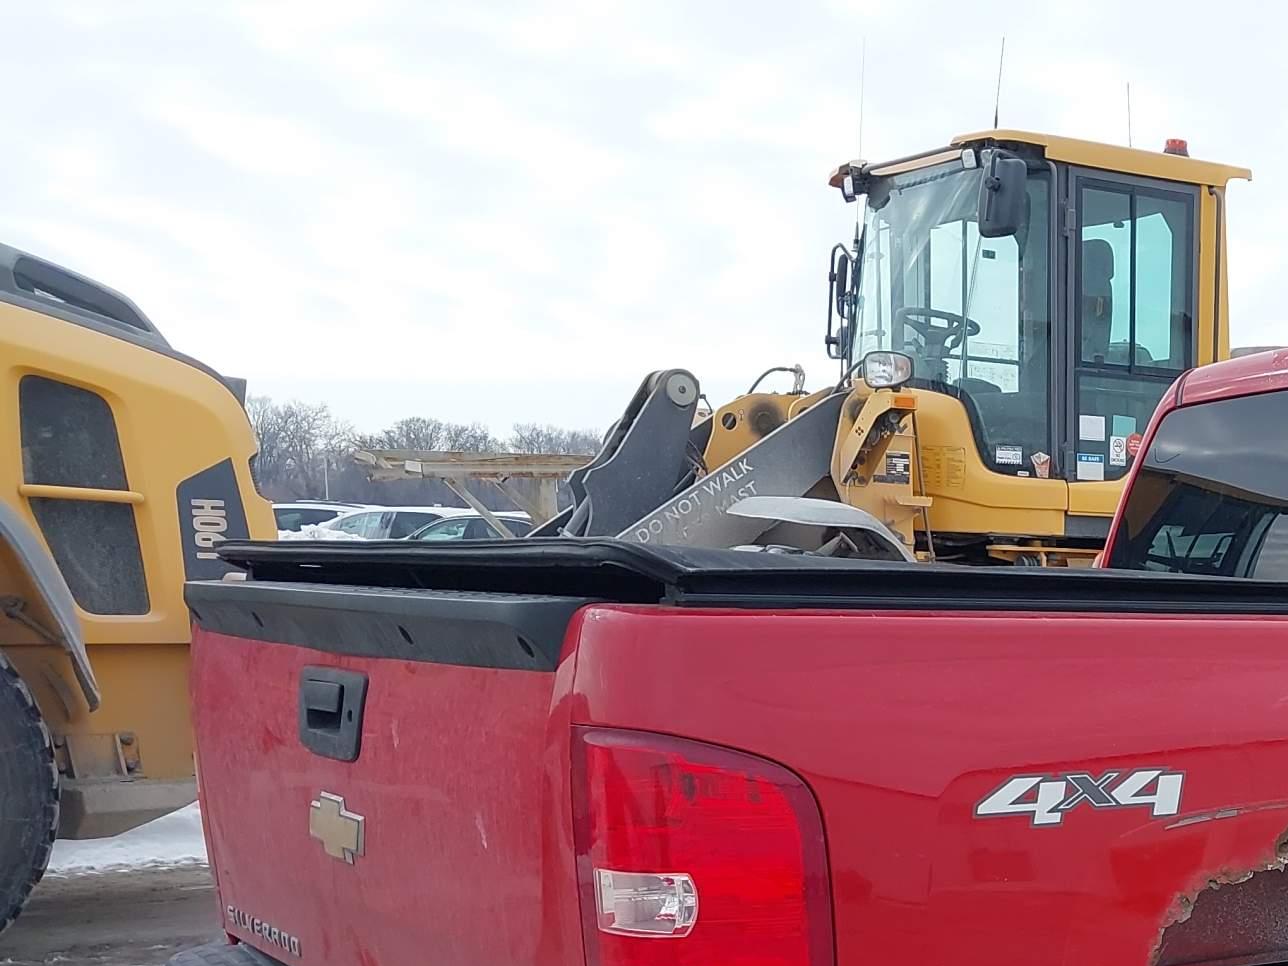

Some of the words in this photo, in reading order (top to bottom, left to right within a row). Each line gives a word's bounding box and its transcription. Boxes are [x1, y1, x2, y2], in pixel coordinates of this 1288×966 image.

[635, 519, 663, 544] DO
[664, 490, 702, 521] NOT
[703, 458, 754, 496] WALK
[226, 905, 301, 958] SILVERADO
